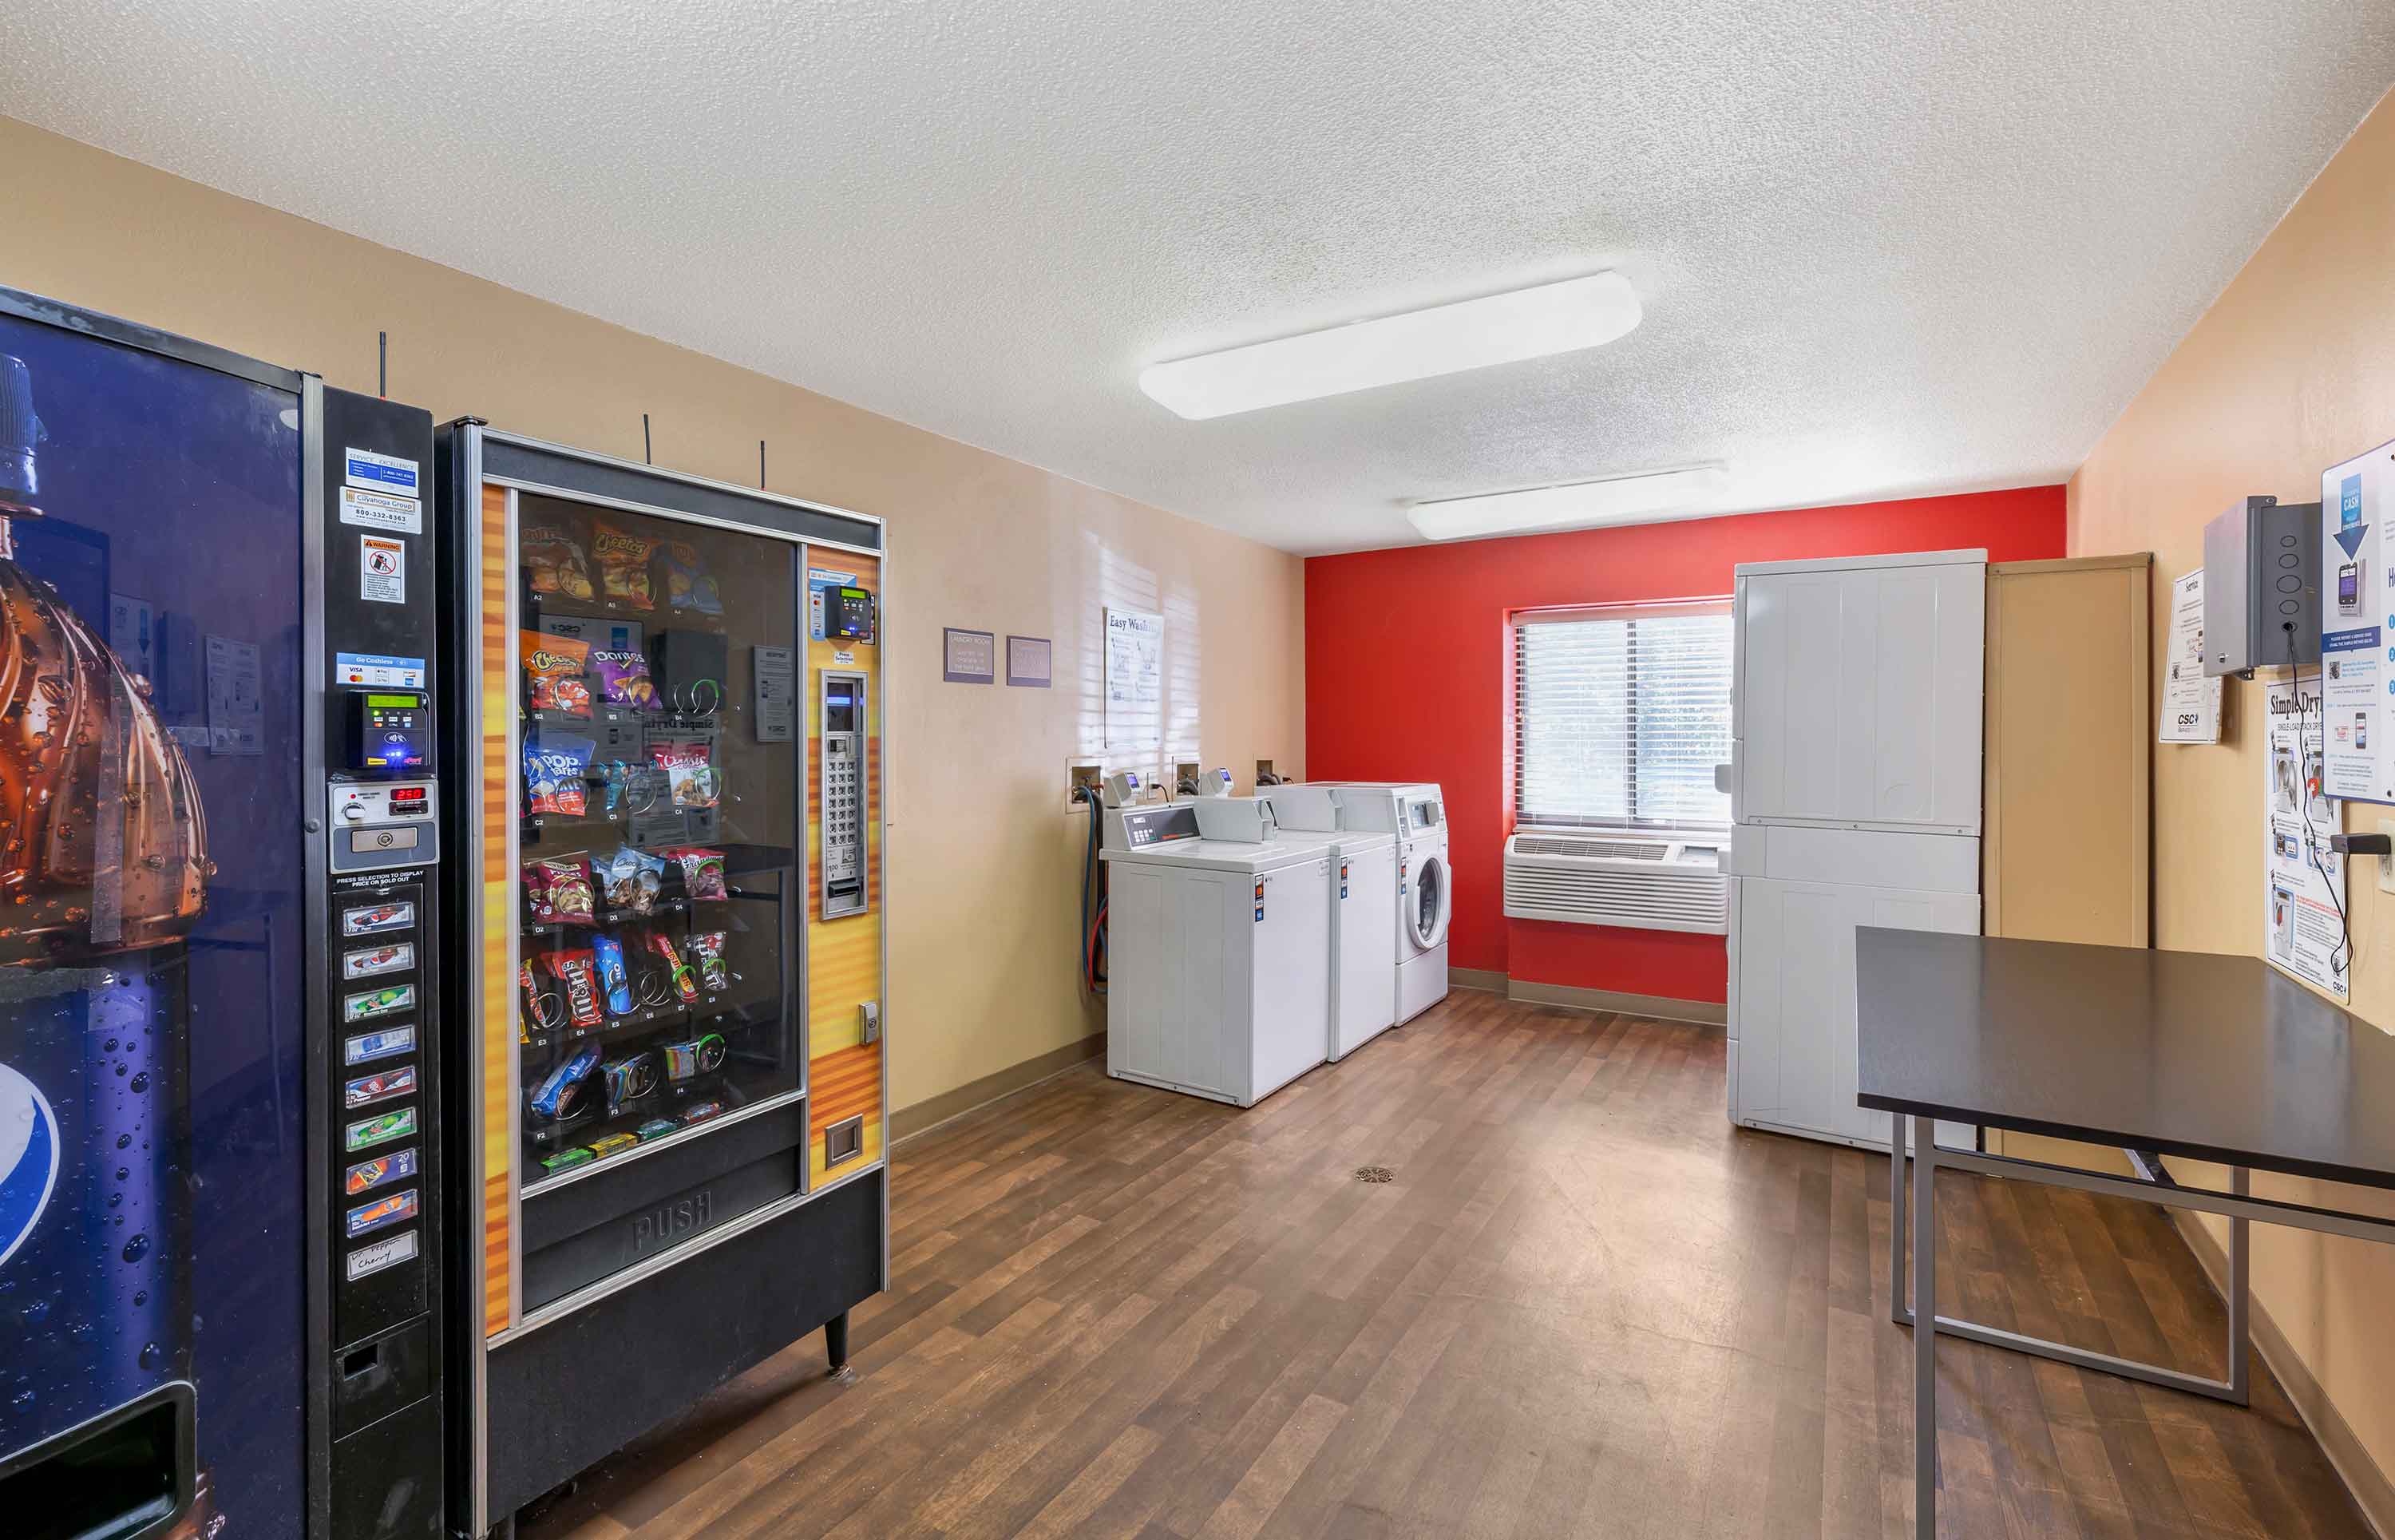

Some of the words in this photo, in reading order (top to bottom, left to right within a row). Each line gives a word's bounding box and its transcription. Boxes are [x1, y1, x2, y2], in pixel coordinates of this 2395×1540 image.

[379, 459, 414, 470] EXCELLENCE
[357, 494, 390, 506] Cuyahoga
[392, 501, 413, 510] Group
[2343, 497, 2359, 512] CASH
[373, 542, 400, 551] WARNING
[1110, 615, 1126, 631] Easy
[2178, 715, 2195, 725] CSC
[2333, 981, 2344, 993] CSC
[398, 1152, 410, 1163] 20
[632, 1189, 711, 1252] PUSH
[358, 1249, 391, 1269] Cherry
